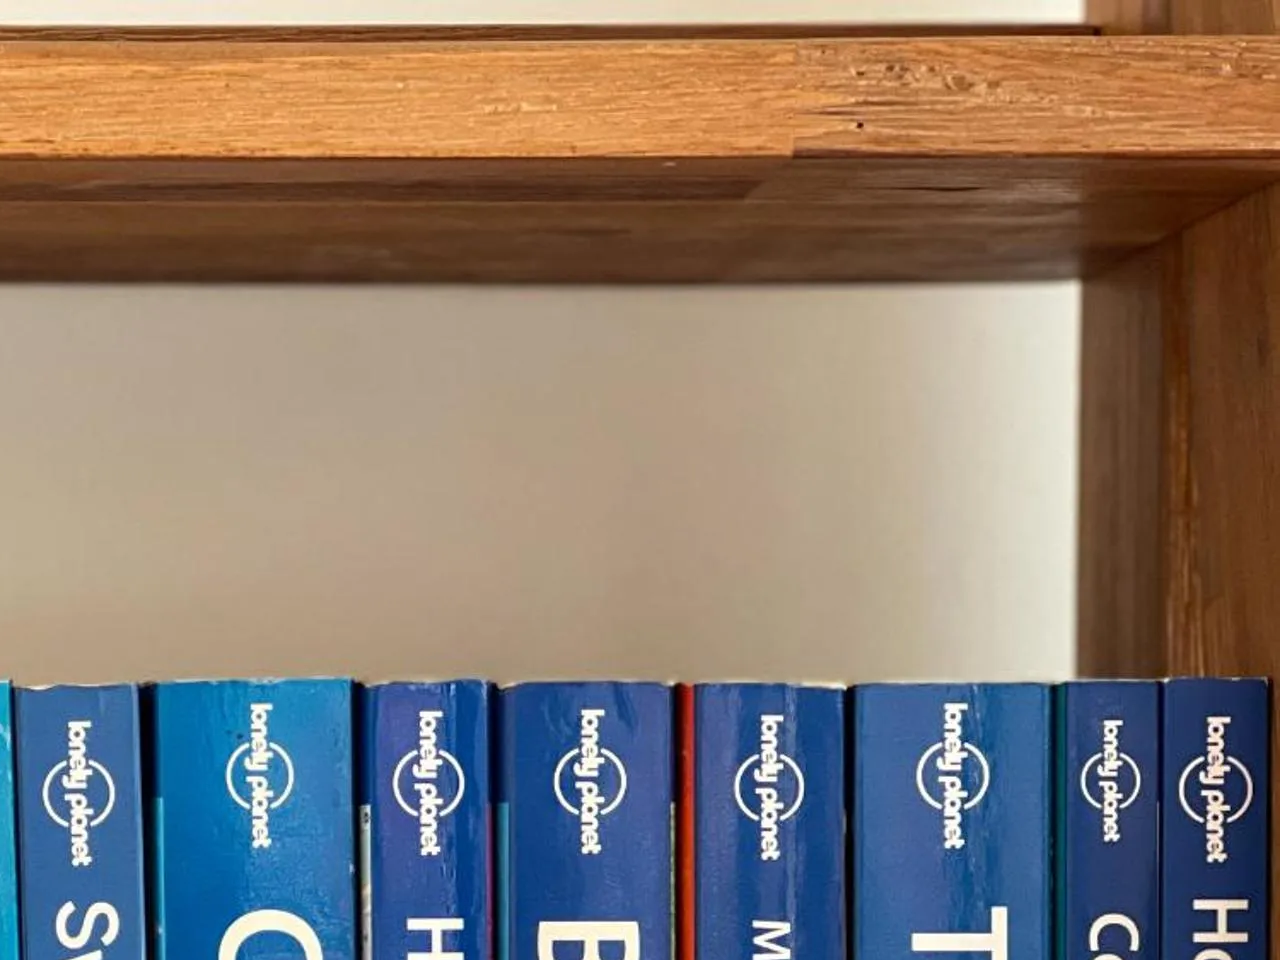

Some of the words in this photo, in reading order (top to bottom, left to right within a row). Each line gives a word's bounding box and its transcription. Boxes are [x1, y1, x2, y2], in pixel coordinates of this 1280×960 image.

[65, 720, 92, 789] lonely
[246, 702, 273, 771] lonely
[414, 710, 443, 779] lonely
[575, 709, 604, 777] lonely
[758, 715, 785, 783] lonely
[940, 702, 968, 771] lonely
[1098, 720, 1123, 779] lonely
[1201, 716, 1231, 786] lonely
[67, 795, 94, 867] planet
[246, 778, 272, 849] planet
[414, 785, 442, 856] planet
[575, 784, 602, 855] planet
[758, 789, 785, 861] planet
[938, 777, 965, 850] planet
[1099, 781, 1120, 842] planet
[1201, 790, 1227, 863] planet
